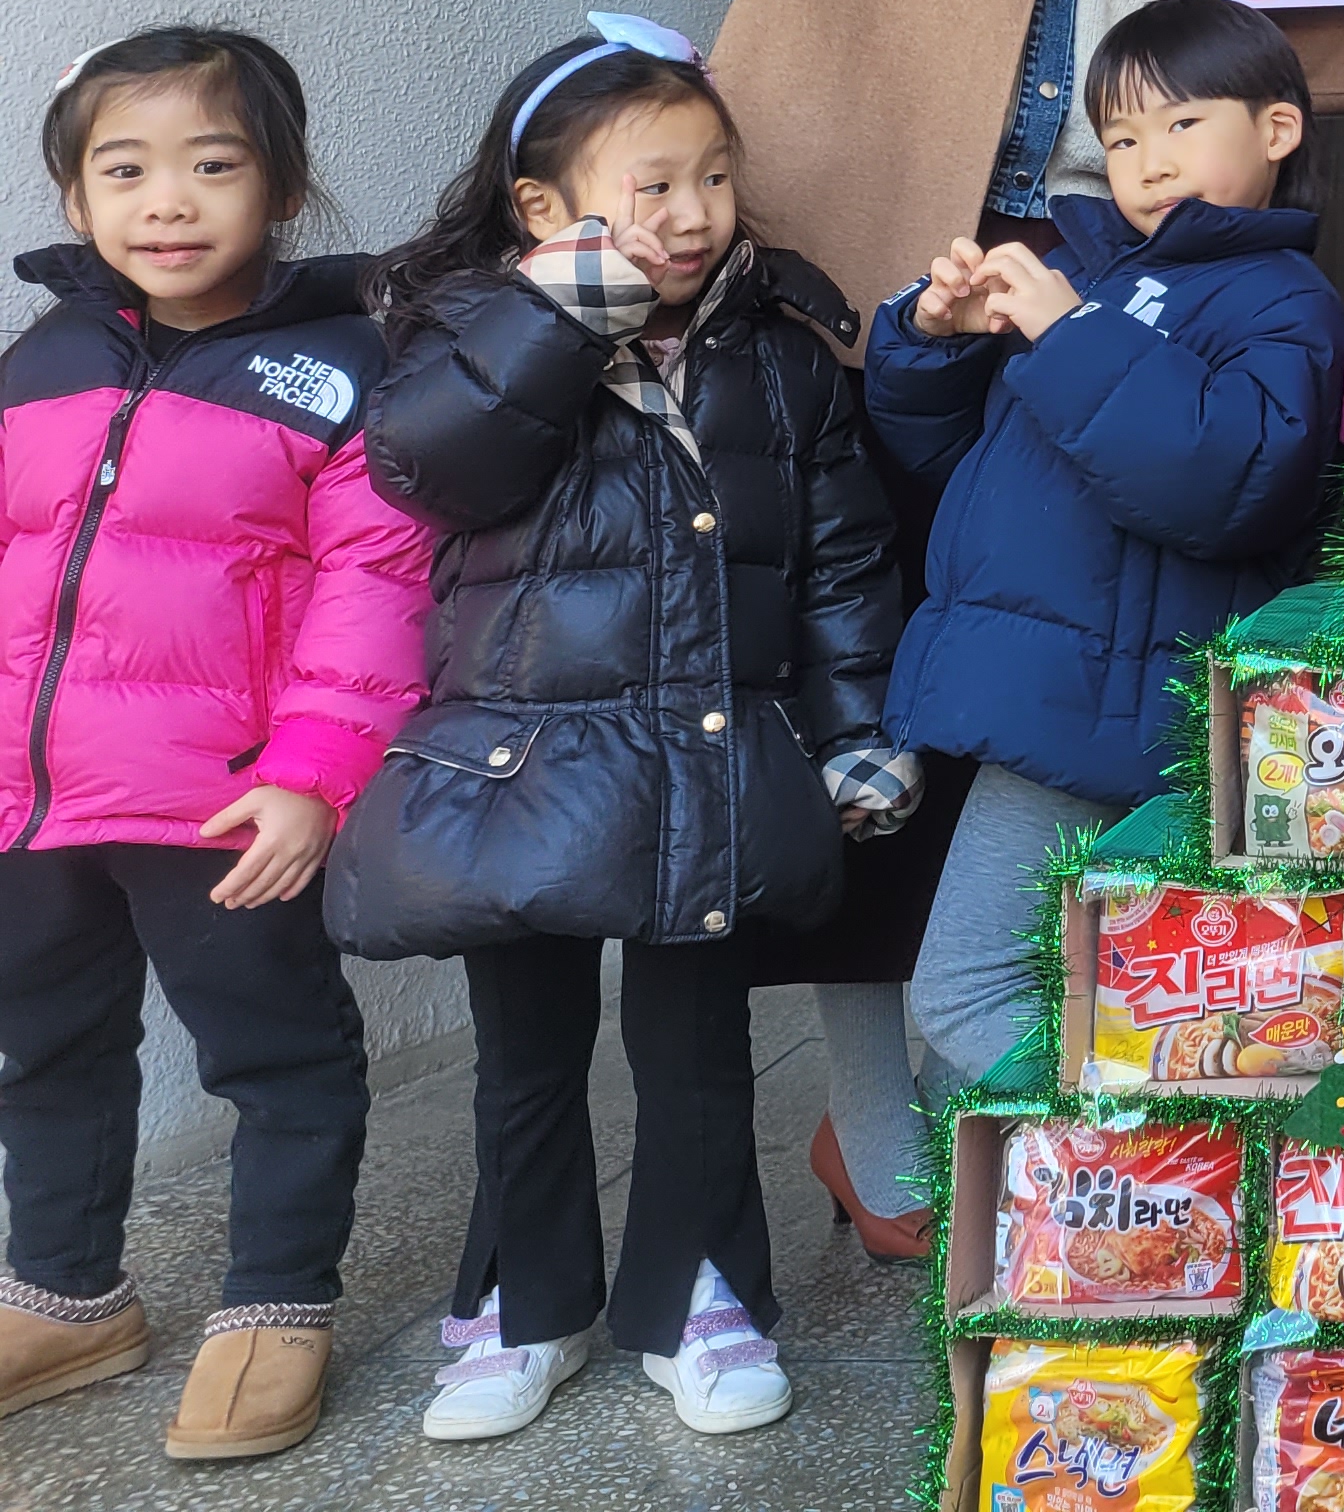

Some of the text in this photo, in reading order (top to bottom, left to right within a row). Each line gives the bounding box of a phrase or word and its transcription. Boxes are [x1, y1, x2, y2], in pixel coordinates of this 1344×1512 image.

[247, 355, 325, 395] NORTH
[291, 354, 333, 381] THE
[259, 377, 316, 409] FACE
[1269, 735, 1297, 751] 다시마
[1264, 758, 1298, 783] 2개!
[1202, 924, 1227, 936] 오뚜기
[1125, 947, 1304, 1031] 진라면
[1266, 1020, 1310, 1043] 매운맛
[1014, 1429, 1141, 1498] 스낵면
